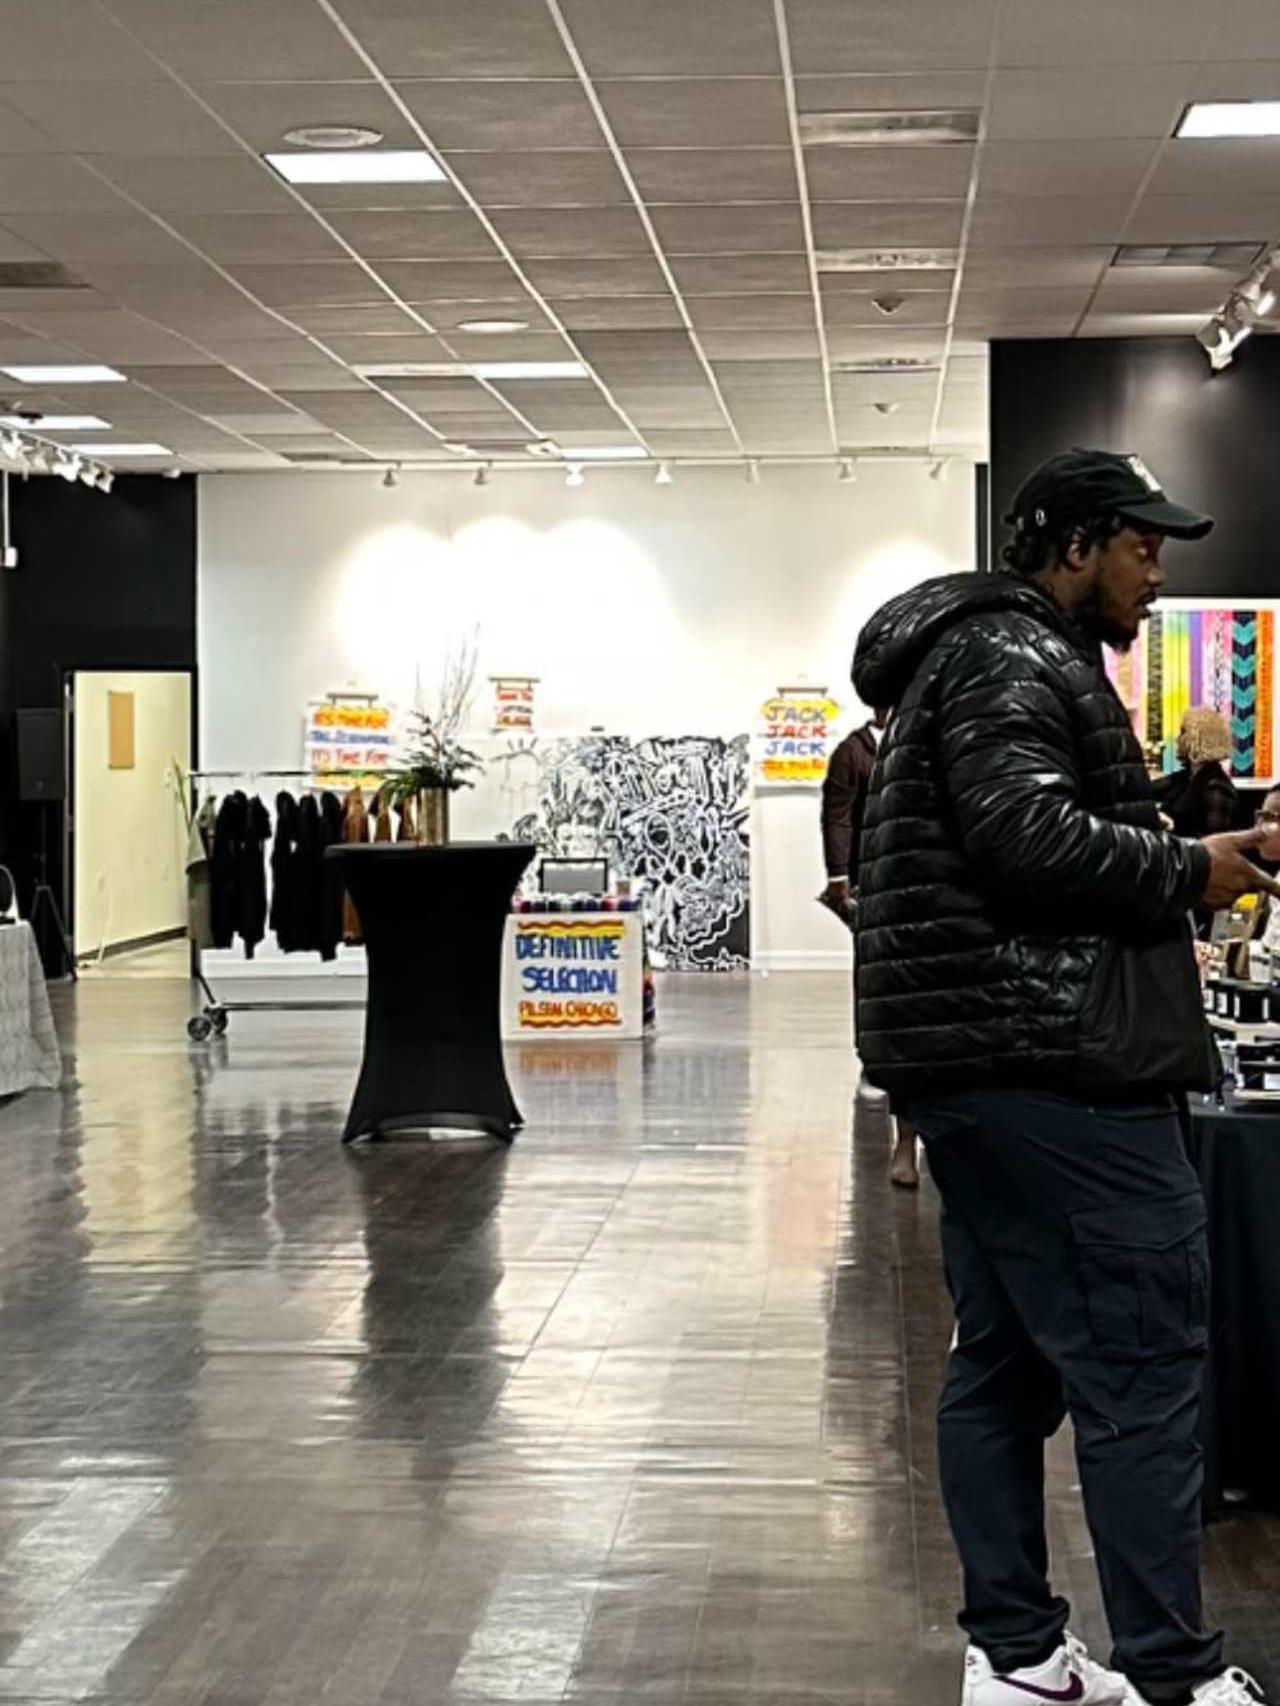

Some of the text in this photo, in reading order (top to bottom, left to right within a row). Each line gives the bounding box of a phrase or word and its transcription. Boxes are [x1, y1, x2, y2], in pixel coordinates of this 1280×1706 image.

[765, 705, 826, 724] JACK
[767, 724, 827, 739] JACK
[765, 740, 826, 757] JACK
[516, 933, 621, 960] DEFINITIVE
[522, 966, 618, 994] SELECTION
